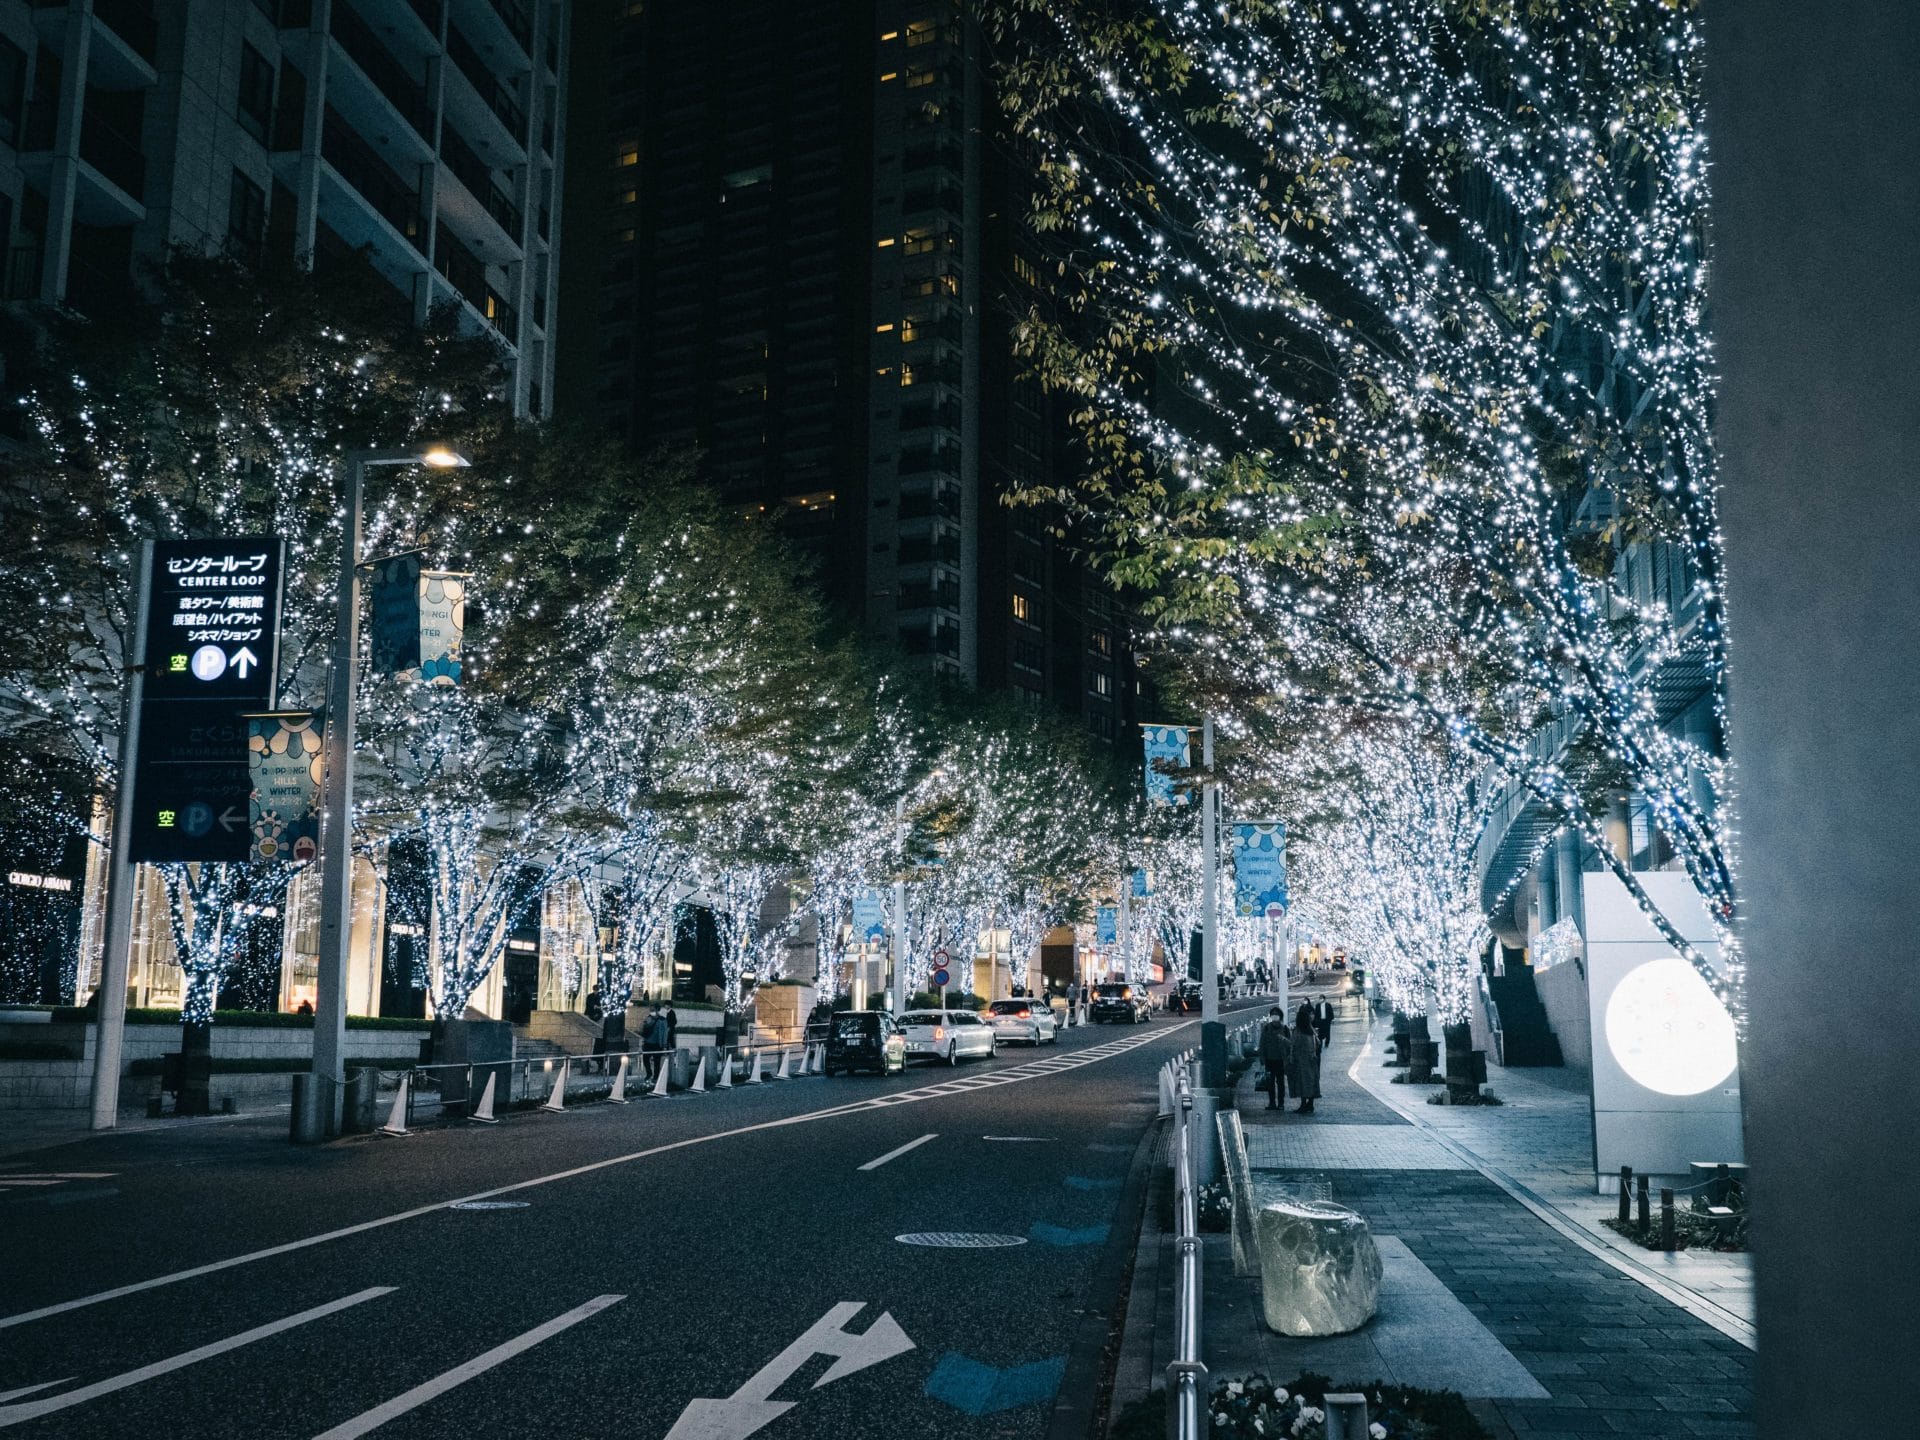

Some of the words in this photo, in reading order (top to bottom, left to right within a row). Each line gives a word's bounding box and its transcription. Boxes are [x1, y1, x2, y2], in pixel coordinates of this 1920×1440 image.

[166, 553, 267, 573] センターループ
[178, 576, 228, 587] CENTER
[231, 575, 265, 586] LOOP
[169, 654, 188, 671] 空
[269, 787, 301, 796] WINTER
[157, 810, 175, 828] 空
